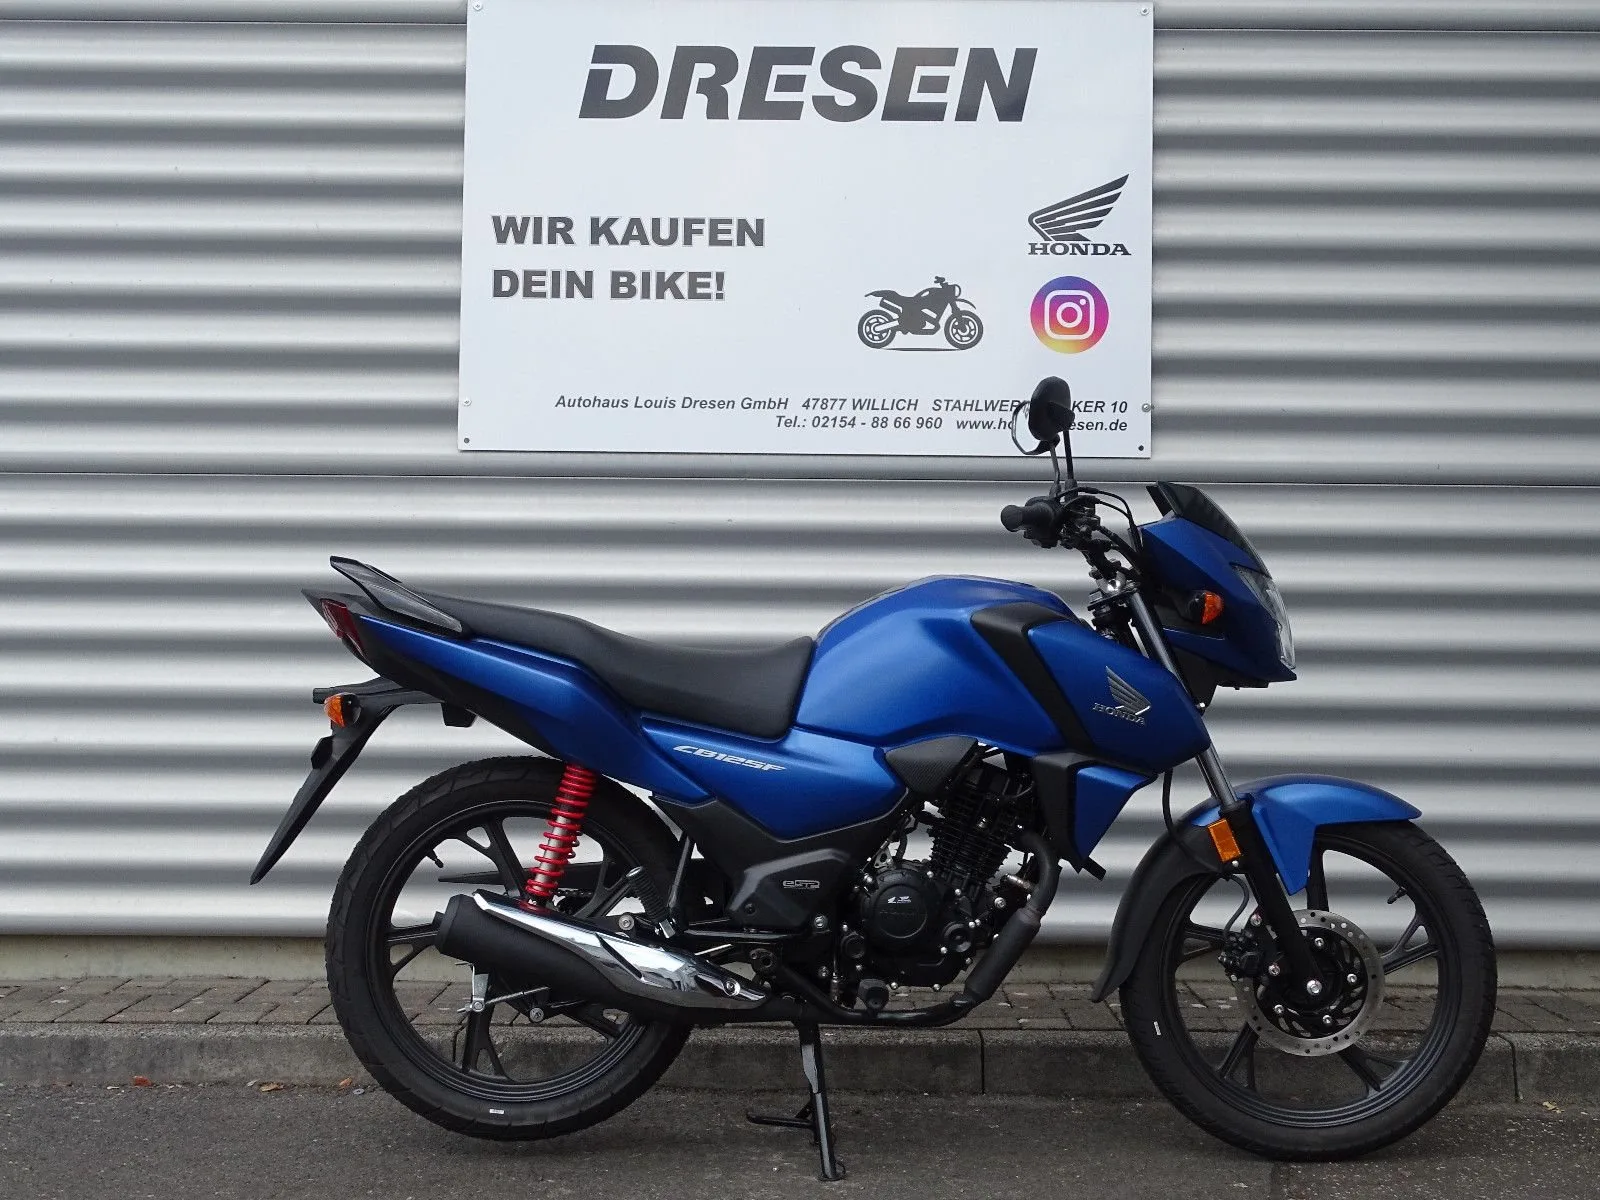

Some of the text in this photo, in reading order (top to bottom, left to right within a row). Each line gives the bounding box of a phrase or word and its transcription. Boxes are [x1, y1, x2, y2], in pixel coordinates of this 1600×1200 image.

[579, 44, 1037, 123] DRESEN
[491, 215, 765, 247] WIR KAUFEN
[1028, 242, 1132, 256] HONDA
[493, 269, 725, 300] DEIN BIKE!
[555, 395, 629, 409] Autohaus
[634, 396, 677, 409] Louis
[681, 396, 736, 410] Dresen
[740, 397, 789, 410] GmbH
[801, 398, 848, 411] 47877
[852, 398, 919, 411] WILLICH
[932, 399, 1021, 412] STAHLWER
[1111, 401, 1128, 413] 10
[776, 415, 807, 428] Tel.:
[811, 416, 857, 428] 02154
[871, 416, 889, 429] 88
[893, 416, 912, 429] 66
[915, 417, 943, 430] 960
[1092, 702, 1145, 725] HONDA
[673, 745, 787, 771] CB125F
